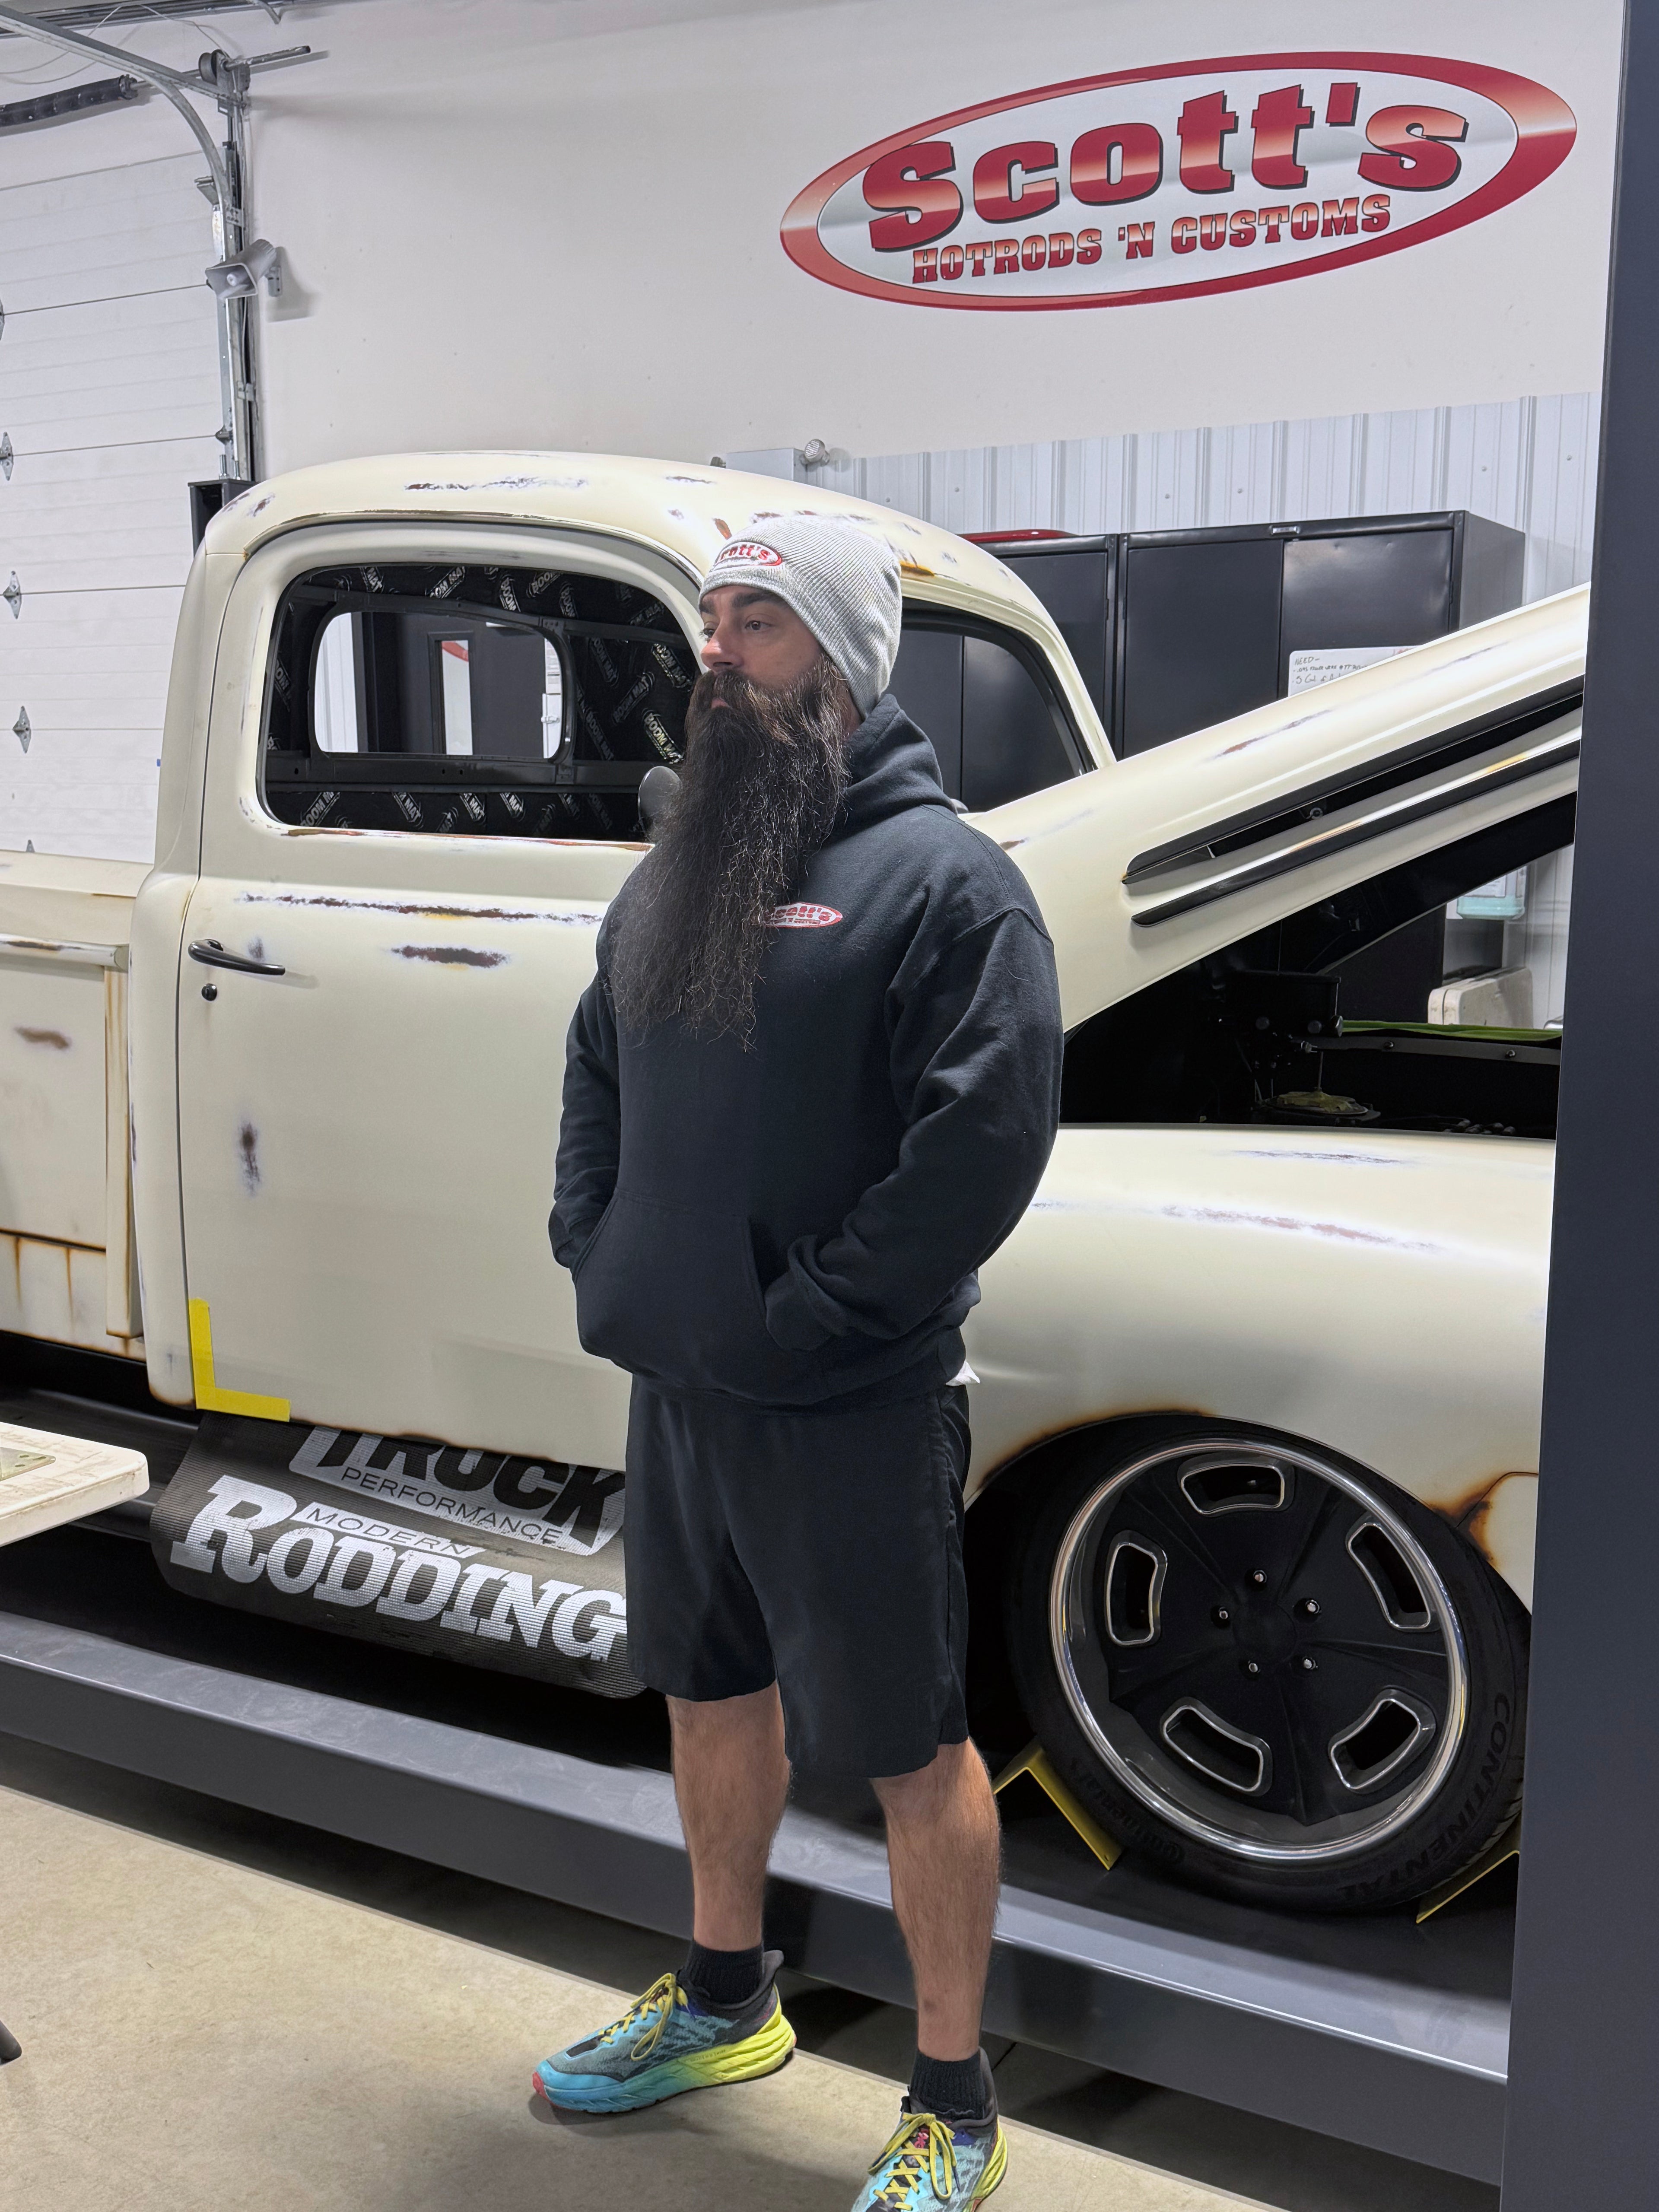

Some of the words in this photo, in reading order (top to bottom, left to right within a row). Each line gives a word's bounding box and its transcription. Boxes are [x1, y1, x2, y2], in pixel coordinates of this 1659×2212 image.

[862, 83, 1468, 252] Scott's
[912, 229, 1102, 283] HOTRODS
[1118, 221, 1155, 259] 'N
[1171, 194, 1390, 254] CUSTOMS
[500, 577, 517, 610] BOOM
[531, 572, 554, 594] BOO
[592, 638, 608, 661] OOM
[644, 712, 668, 746] BOOM
[404, 797, 421, 822] MAT
[469, 797, 485, 821] MAT
[765, 906, 831, 921] cott's
[341, 1467, 563, 1544] PERFORMANCE
[306, 1508, 470, 1554] MODERN
[170, 1475, 626, 1663] RODDING
